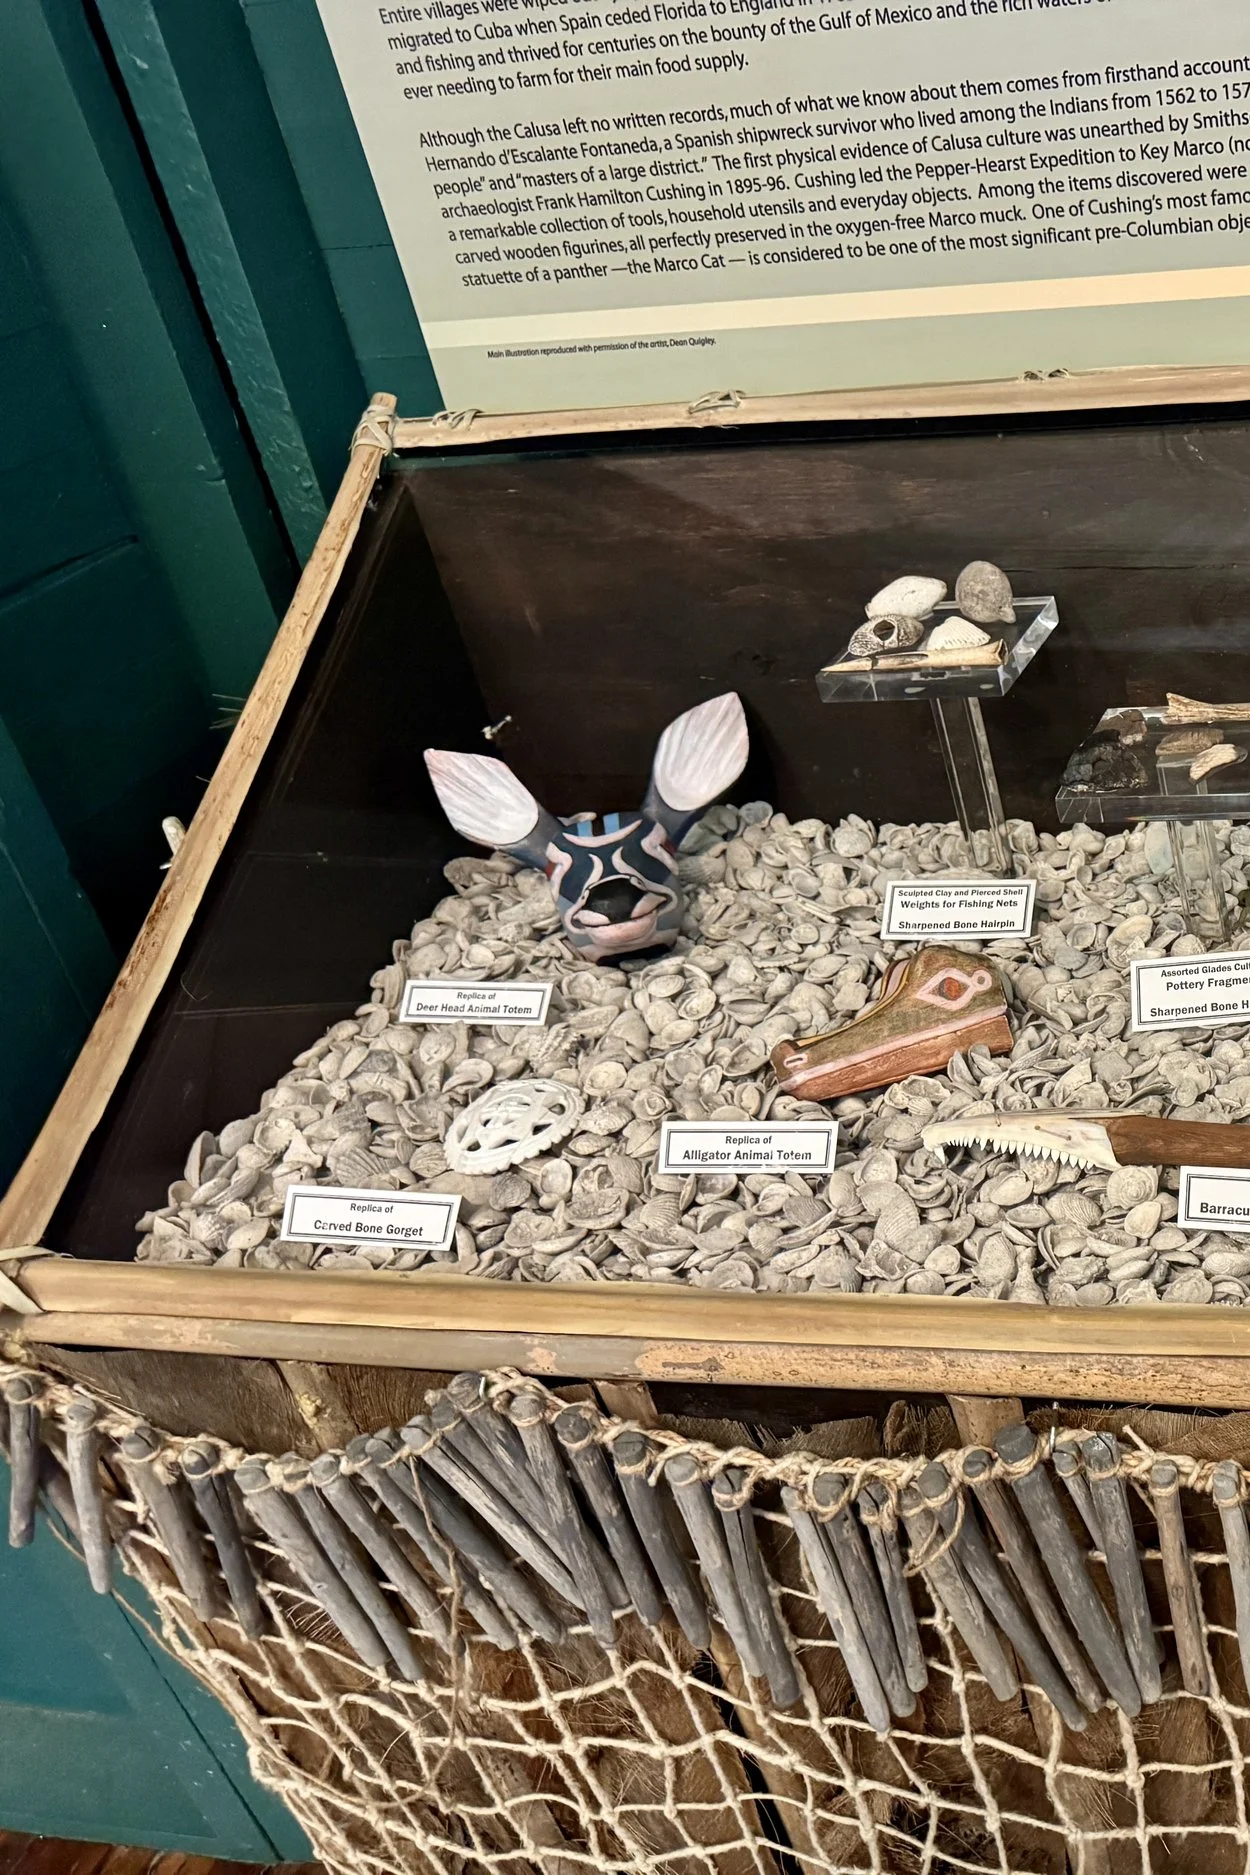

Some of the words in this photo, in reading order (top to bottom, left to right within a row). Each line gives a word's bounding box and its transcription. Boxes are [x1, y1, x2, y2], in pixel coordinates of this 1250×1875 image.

[404, 85, 433, 99] ever
[437, 76, 497, 96] needing
[498, 76, 515, 90] to
[517, 71, 552, 88] farm
[553, 67, 574, 84] for
[577, 63, 612, 82] their
[615, 59, 653, 79] main
[656, 54, 692, 74] food
[695, 50, 749, 73] supply.
[442, 196, 533, 218] archaeologist
[536, 189, 574, 212] Frank
[578, 189, 644, 206] Hamilton
[646, 183, 706, 201] Cushing
[708, 181, 723, 196] in
[726, 175, 790, 195] 1895-96.
[795, 170, 856, 189] Cushing
[859, 165, 883, 184] led
[886, 164, 913, 181] the
[916, 156, 1027, 181] Pepper-Hearst
[1030, 148, 1115, 172] Expedition
[1118, 147, 1136, 162] to
[1140, 143, 1169, 163] Key
[1174, 140, 1224, 158] Marco
[456, 246, 502, 264] carved
[503, 242, 561, 260] wooden
[562, 238, 628, 259] figurines,
[629, 234, 646, 251] all
[648, 230, 711, 253] perfectly
[714, 223, 787, 248] preserved
[789, 223, 805, 238] in
[807, 220, 833, 237] the
[836, 213, 925, 238] oxygen-free
[929, 211, 976, 228] Marco
[980, 205, 1026, 224] muck.
[1032, 203, 1065, 219] One
[1069, 199, 1085, 217] of
[1088, 194, 1163, 216] Cushing's
[1167, 192, 1208, 210] most
[488, 350, 504, 358] Main
[505, 348, 540, 357] illustration
[540, 345, 577, 356] reproduced
[578, 344, 593, 352] with
[594, 342, 629, 353] permission
[630, 341, 637, 349] of
[638, 340, 649, 349] the
[650, 340, 669, 348] artist,
[670, 338, 688, 347] Dean
[688, 336, 716, 347] Quigley.
[901, 900, 940, 910] Weights
[943, 900, 956, 908] for
[959, 900, 994, 909] Fishing
[996, 899, 1018, 907] Nets
[899, 921, 951, 930] Sharpened
[954, 921, 978, 929] Bone
[981, 920, 1015, 929] Hairpin
[1161, 967, 1199, 977] Assorted
[1202, 965, 1232, 974] Glades
[1167, 981, 1204, 991] Pottery
[457, 992, 486, 1000] Replica
[416, 1003, 438, 1012] Deer
[441, 1003, 465, 1012] Head
[467, 1004, 501, 1013] Animal
[504, 1005, 532, 1014] Totem
[1151, 1003, 1207, 1017] Sharpened
[1211, 1002, 1238, 1012] Bone
[726, 1136, 760, 1146] Replica
[763, 1135, 772, 1144] of
[683, 1150, 731, 1162] Alligator
[734, 1150, 773, 1160] Animal
[777, 1150, 811, 1160] Totem
[350, 1203, 382, 1213] Replica
[385, 1205, 394, 1213] of
[314, 1220, 352, 1232] Carved
[356, 1222, 383, 1234] Bone
[386, 1224, 423, 1238] Gorget
